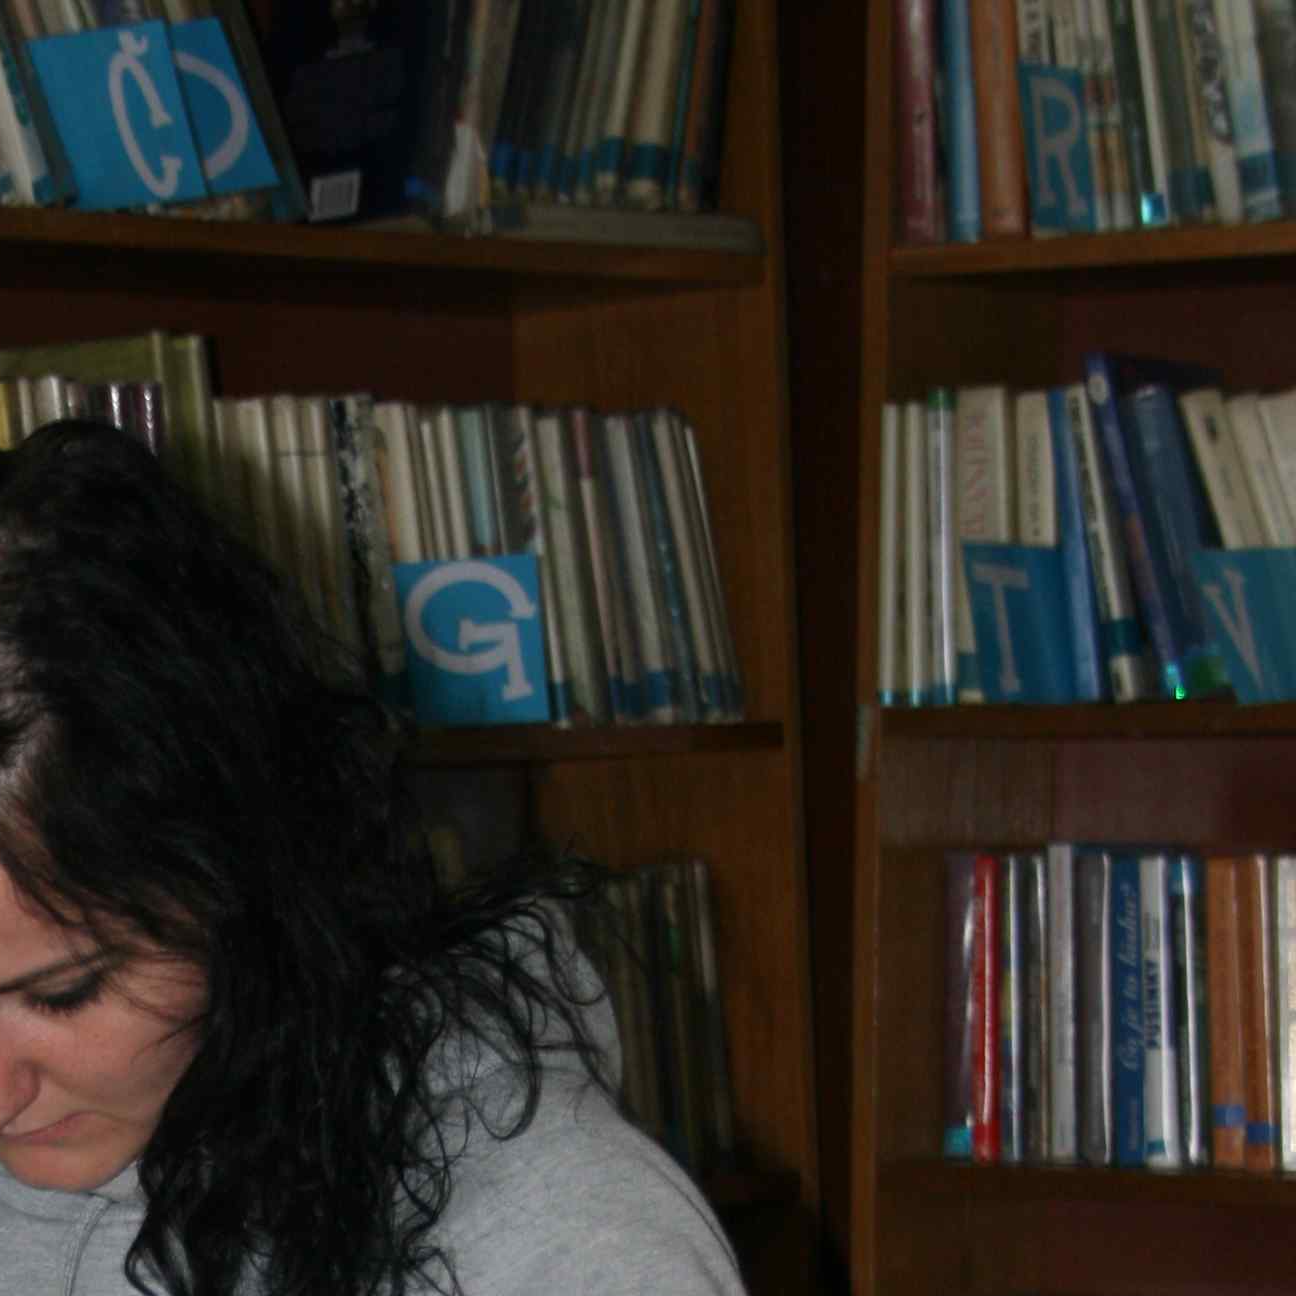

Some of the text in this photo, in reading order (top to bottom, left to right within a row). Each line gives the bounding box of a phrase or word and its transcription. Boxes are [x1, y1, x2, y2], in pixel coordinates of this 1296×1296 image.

[1028, 75, 1090, 218] R
[404, 559, 539, 702] G
[973, 562, 1031, 695] T
